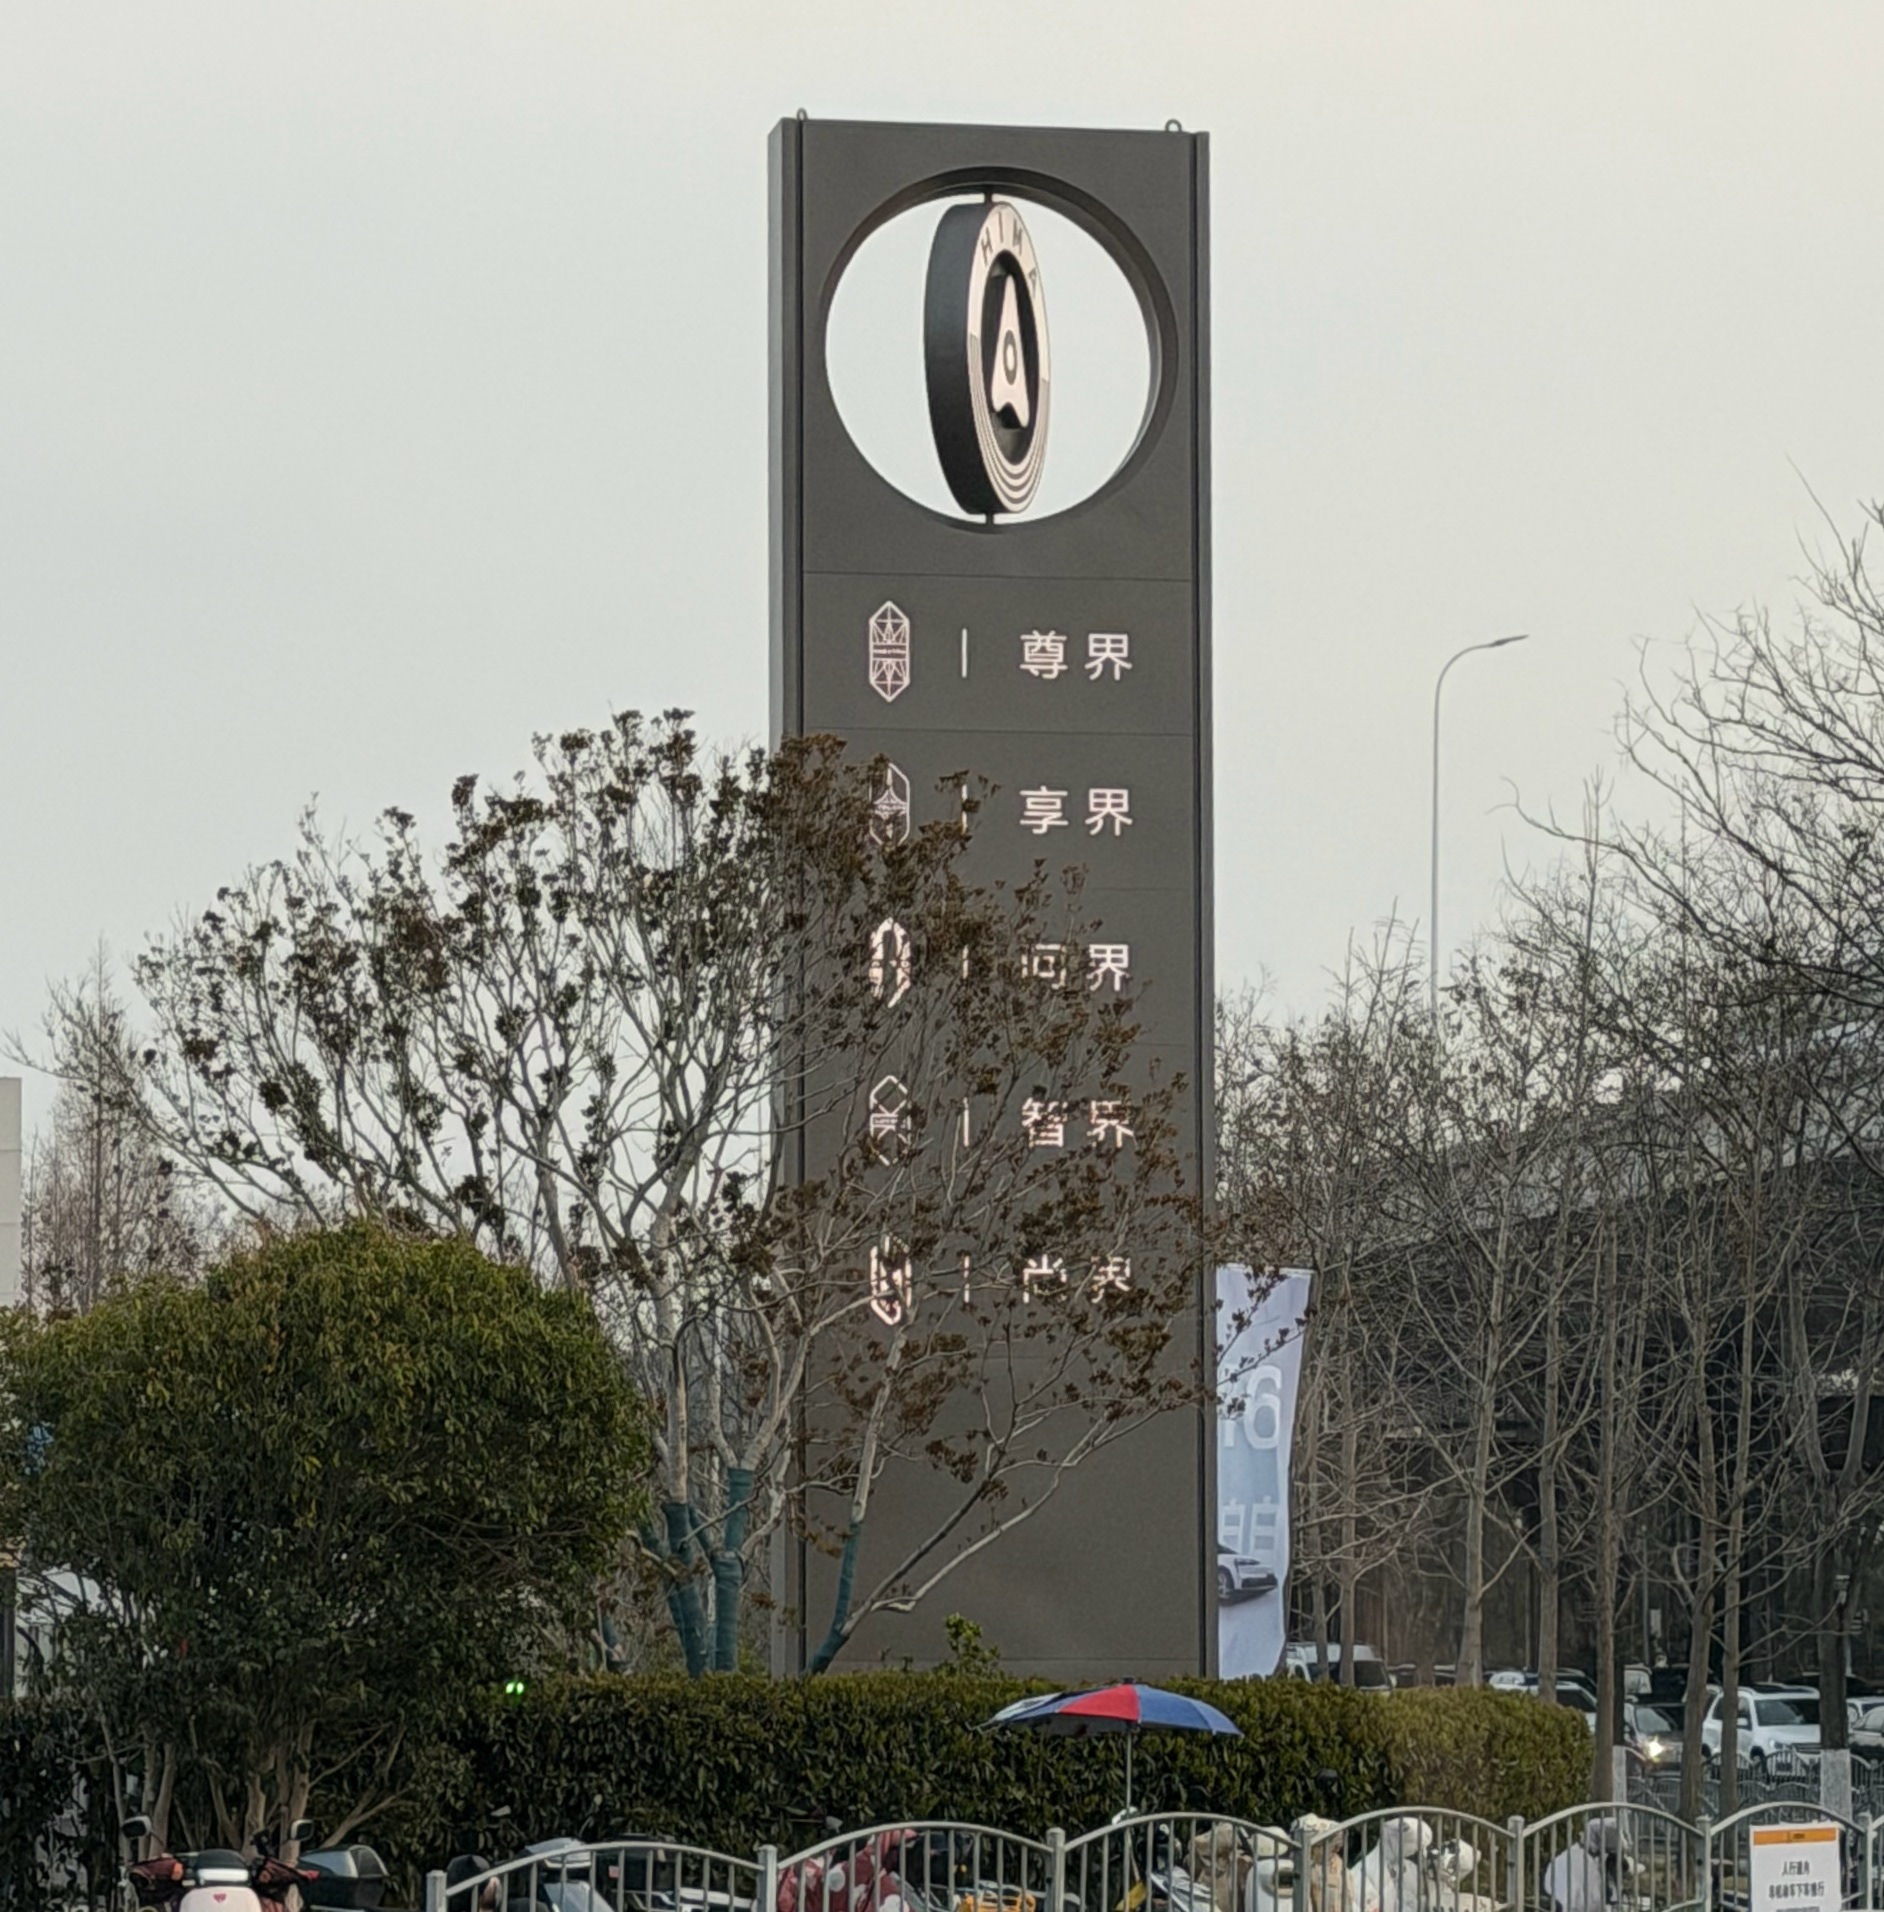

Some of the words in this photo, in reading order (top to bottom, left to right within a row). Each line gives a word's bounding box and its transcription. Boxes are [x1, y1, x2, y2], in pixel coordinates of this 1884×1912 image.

[1020, 630, 1133, 681] 尊界
[1020, 785, 1133, 837] 享界
[1021, 943, 1131, 992] 问界
[1021, 1097, 1134, 1149] 智界
